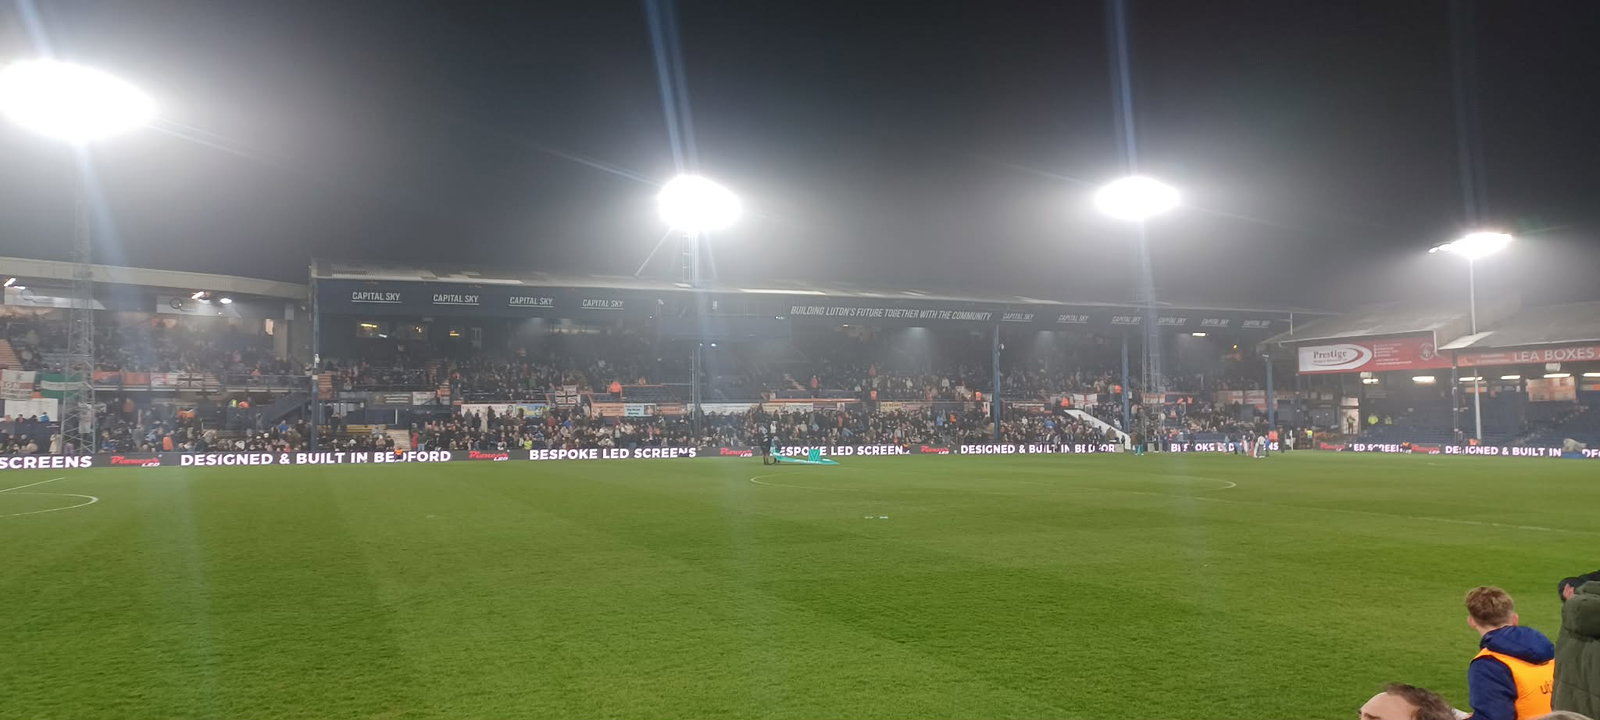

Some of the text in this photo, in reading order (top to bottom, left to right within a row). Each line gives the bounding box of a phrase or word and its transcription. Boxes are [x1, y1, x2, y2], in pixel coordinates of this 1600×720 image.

[352, 291, 401, 301] CAPITAL SKY
[433, 294, 479, 303] CAPITAL SKY
[509, 296, 553, 305] CAPITAL SKY
[582, 299, 624, 308] CAPITAL SKY
[790, 305, 992, 321] BUILDING LUTON'S FUTURE TOGETHER WITH THE COMMUNITY
[1313, 350, 1347, 359] Prestige
[1514, 351, 1540, 362] LEA
[1544, 347, 1595, 361] BOXES
[529, 447, 697, 460] BESPOKE LED SCREENS
[831, 446, 853, 456] LED
[857, 445, 910, 456] SCREEN
[960, 444, 1016, 455] DESIGNED
[1018, 444, 1026, 454] &
[1501, 446, 1509, 456] &
[1512, 446, 1546, 457] BUILT
[1548, 447, 1563, 457] IN
[0, 455, 93, 469] SCREENS
[180, 453, 273, 466] DESIGNED
[279, 453, 290, 465] &
[296, 452, 346, 464] BUILT
[350, 451, 368, 464] IN
